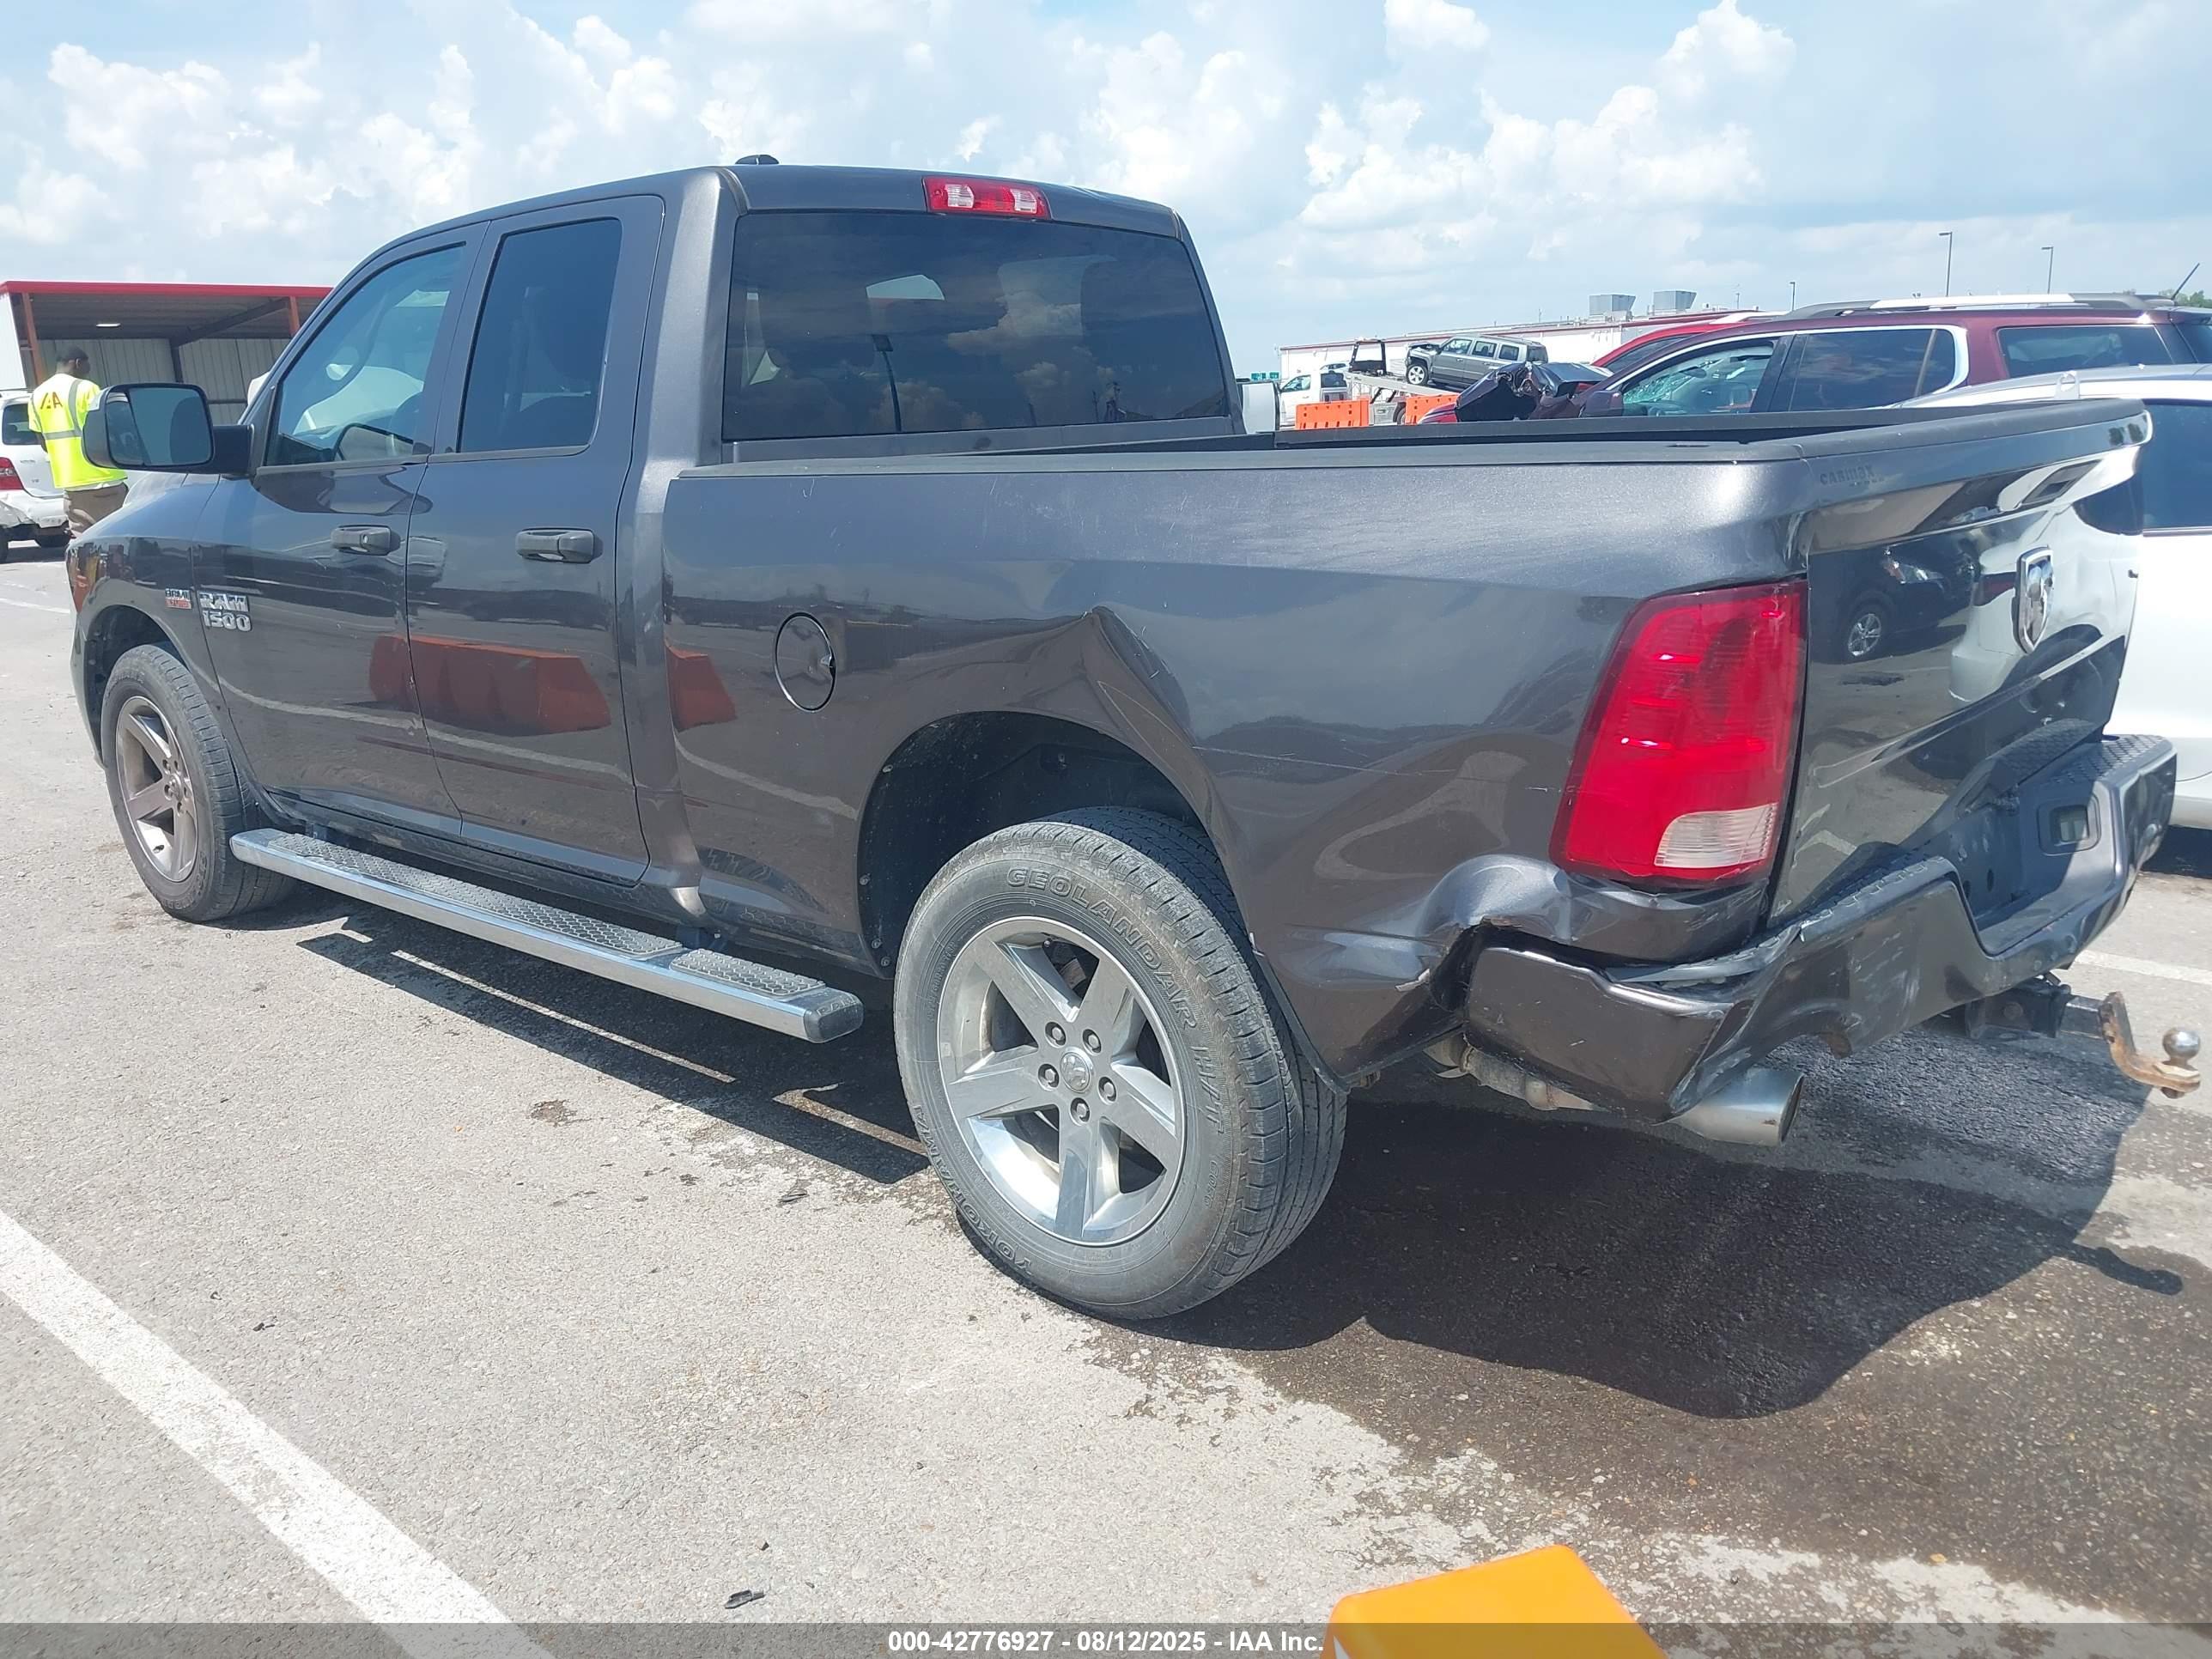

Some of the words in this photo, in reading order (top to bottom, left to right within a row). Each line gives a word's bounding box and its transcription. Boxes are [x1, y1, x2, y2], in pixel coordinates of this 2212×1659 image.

[199, 592, 249, 611] RAM
[202, 610, 252, 632] 1500
[1006, 866, 1199, 1030] GEOLANDAR
[913, 1104, 1034, 1276] YOKOHAMA
